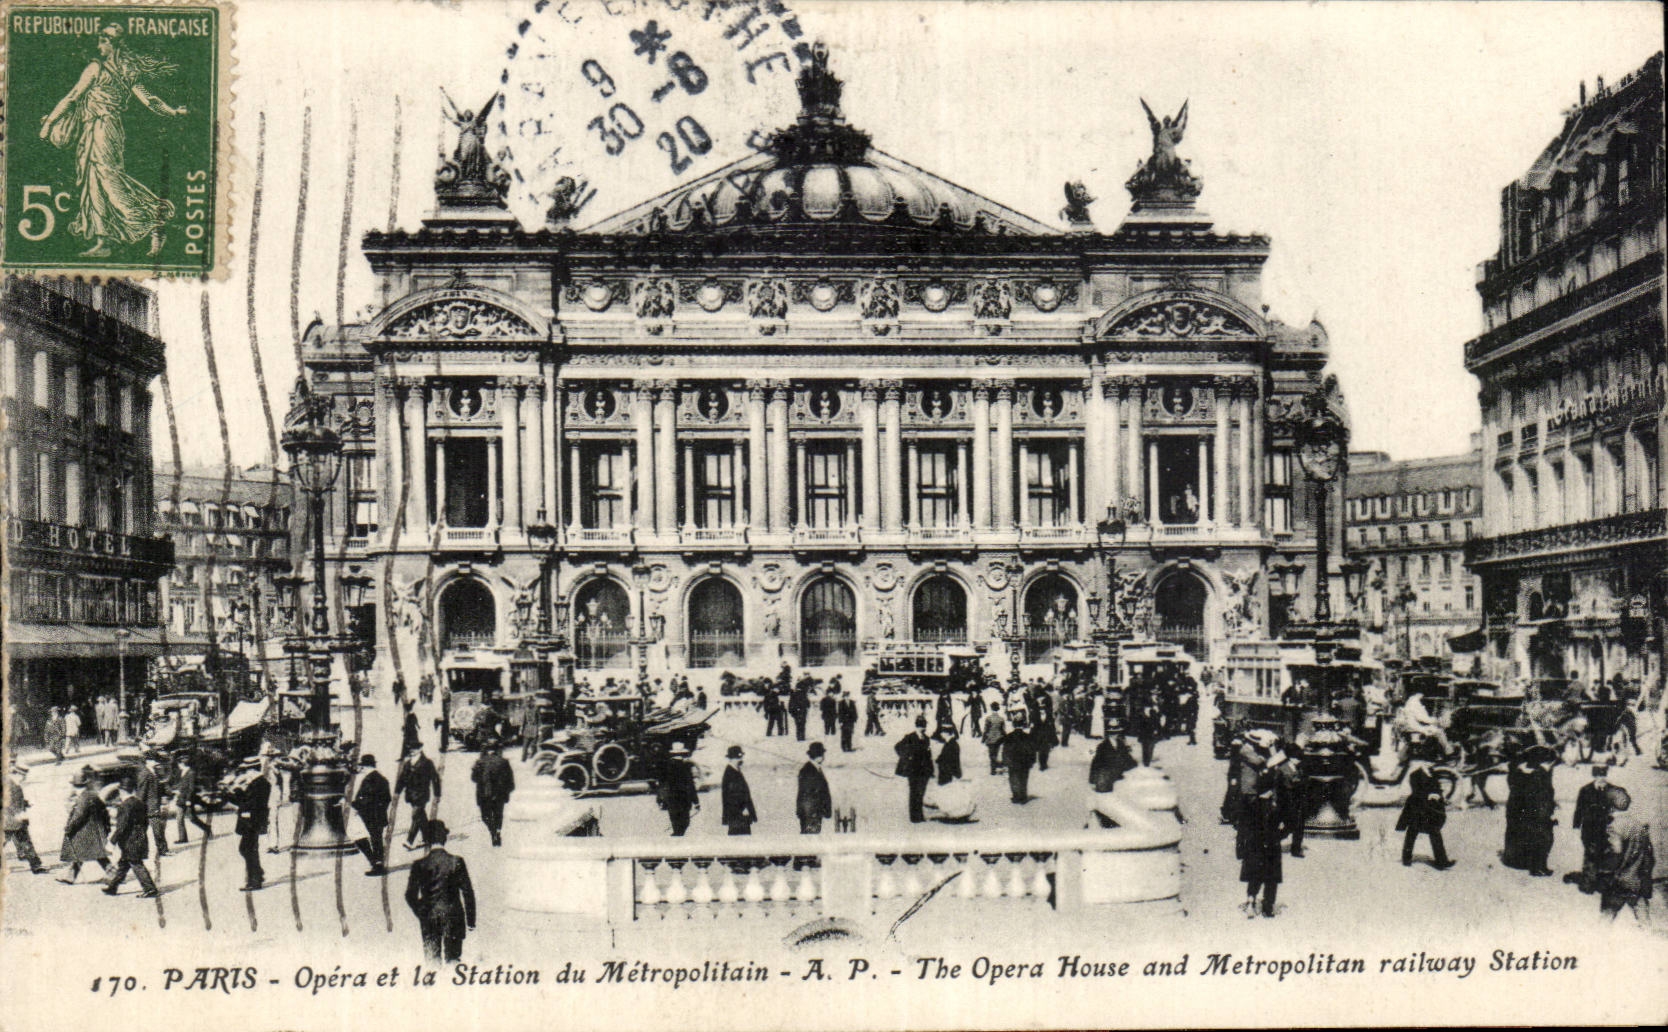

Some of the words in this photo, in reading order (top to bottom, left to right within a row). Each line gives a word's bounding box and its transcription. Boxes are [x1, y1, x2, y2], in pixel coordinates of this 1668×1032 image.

[128, 18, 209, 38] FRANÇAISE
[185, 169, 207, 255] POSTES
[50, 525, 131, 557] HOTEL
